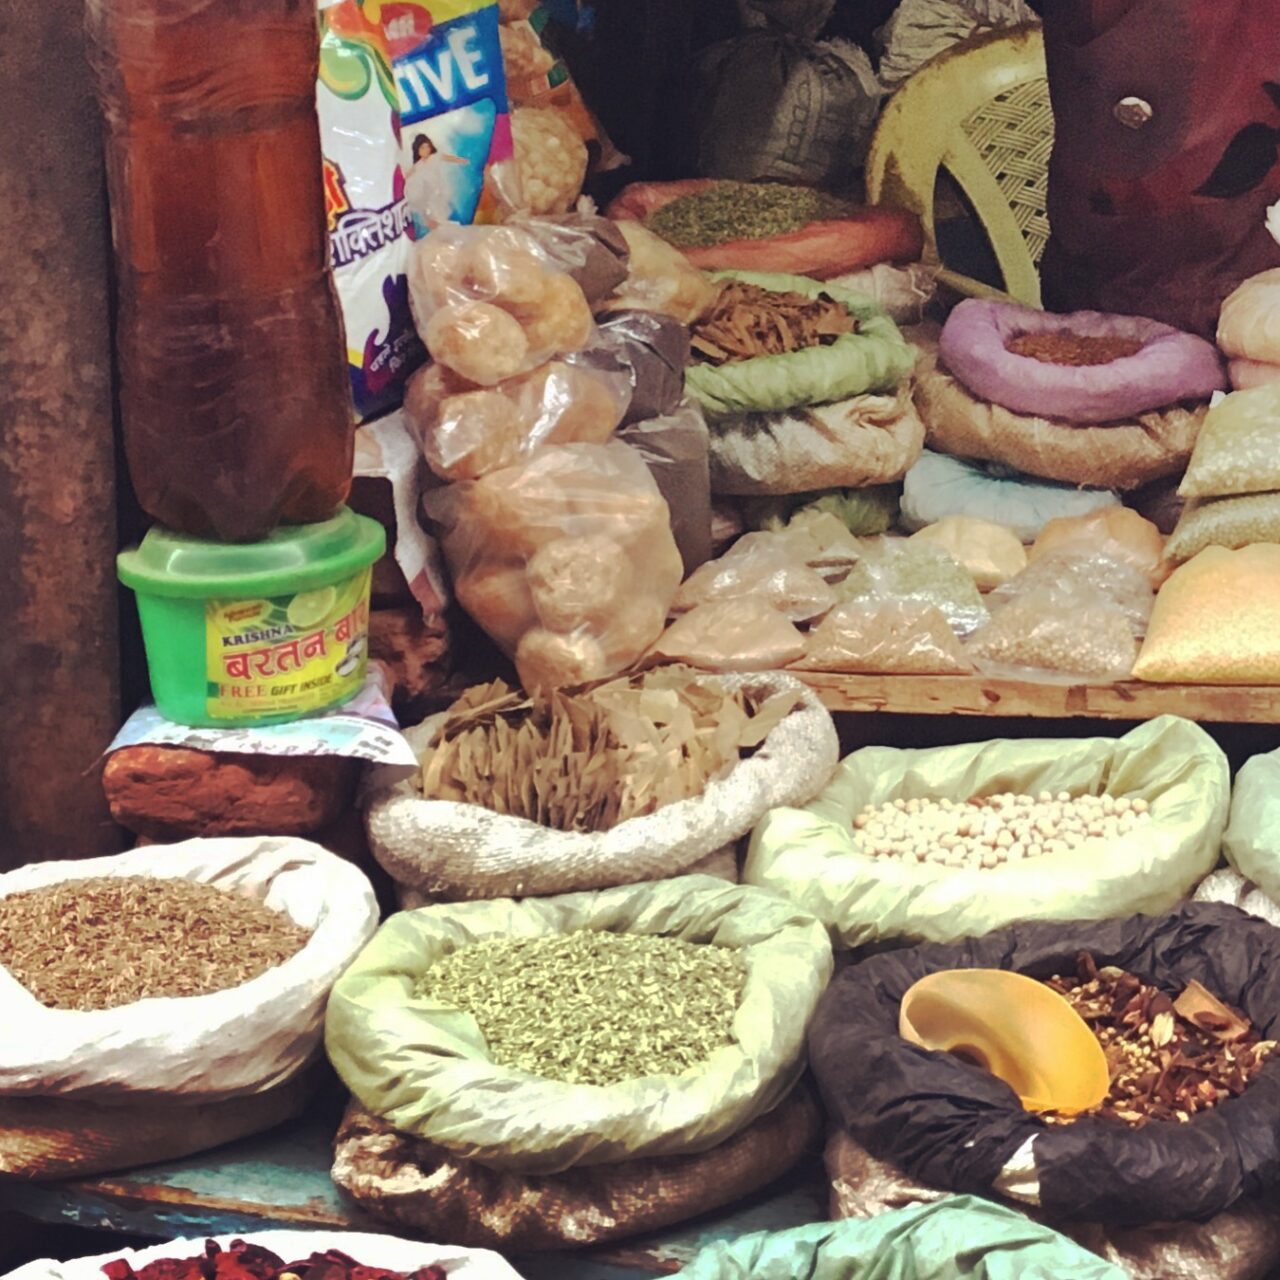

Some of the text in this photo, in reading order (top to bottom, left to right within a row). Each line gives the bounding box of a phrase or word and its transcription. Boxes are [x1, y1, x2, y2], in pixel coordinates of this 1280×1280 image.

[222, 624, 295, 647] KRISHNA
[222, 629, 327, 680] बरतन
[220, 673, 334, 698] FREE GIFT INSIDE
